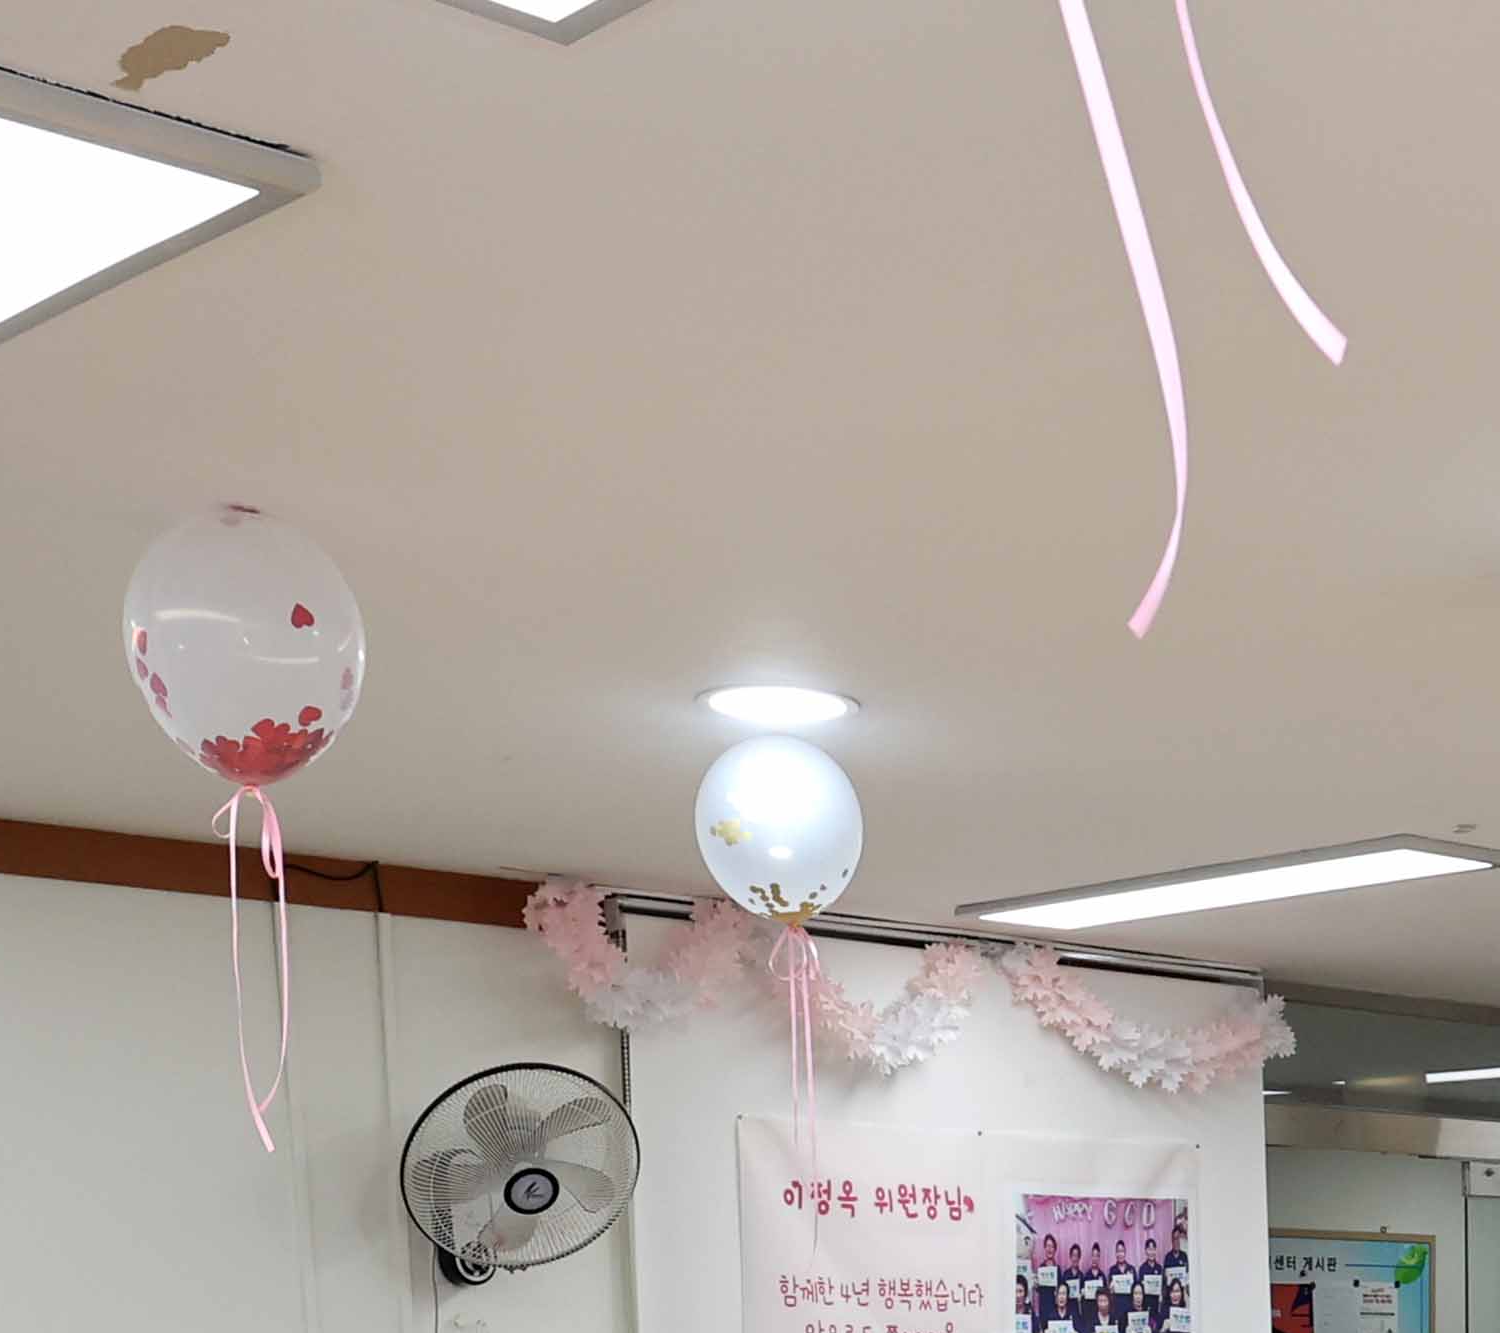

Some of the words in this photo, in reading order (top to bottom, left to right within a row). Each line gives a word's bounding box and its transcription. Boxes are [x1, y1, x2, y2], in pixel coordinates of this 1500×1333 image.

[874, 1184, 963, 1221] 위원장님
[1302, 1256, 1337, 1272] 게시판
[779, 1275, 834, 1307] 함께한
[840, 1278, 869, 1306] 4년
[878, 1278, 985, 1312] 행복했습니다
